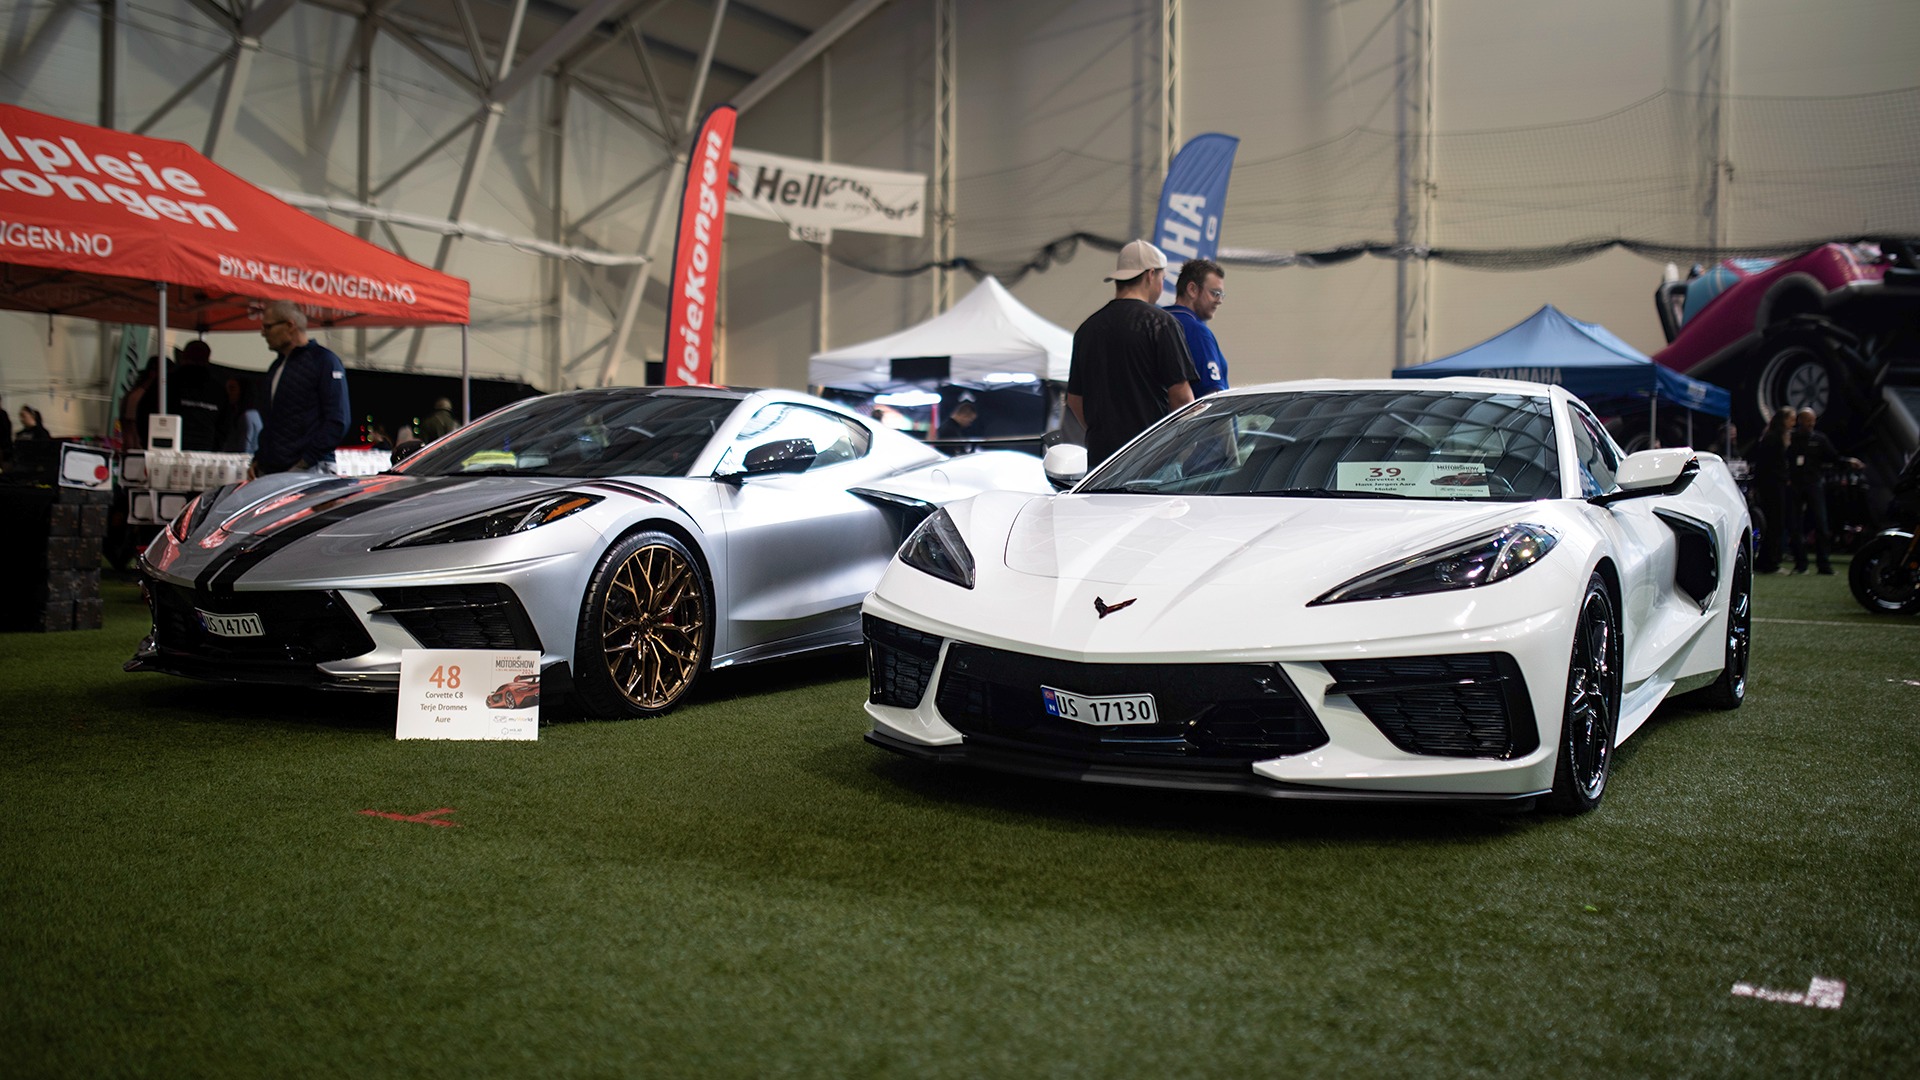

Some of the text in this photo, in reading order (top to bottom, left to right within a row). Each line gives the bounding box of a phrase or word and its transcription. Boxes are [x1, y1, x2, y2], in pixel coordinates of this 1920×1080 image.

[753, 166, 825, 209] Hell
[0, 168, 238, 232] ongen
[218, 253, 416, 305] BILPLEIEKONGEN.NO
[1207, 361, 1221, 380] 3
[1369, 467, 1402, 477] 39
[218, 618, 260, 635] 14701
[495, 660, 535, 669] MOTORSHOW
[429, 665, 461, 689] 48
[425, 691, 464, 699] Corvette C8
[420, 703, 437, 712] Terje
[1056, 695, 1078, 718] US
[1089, 700, 1151, 722] 17130
[435, 716, 451, 724] Aure
